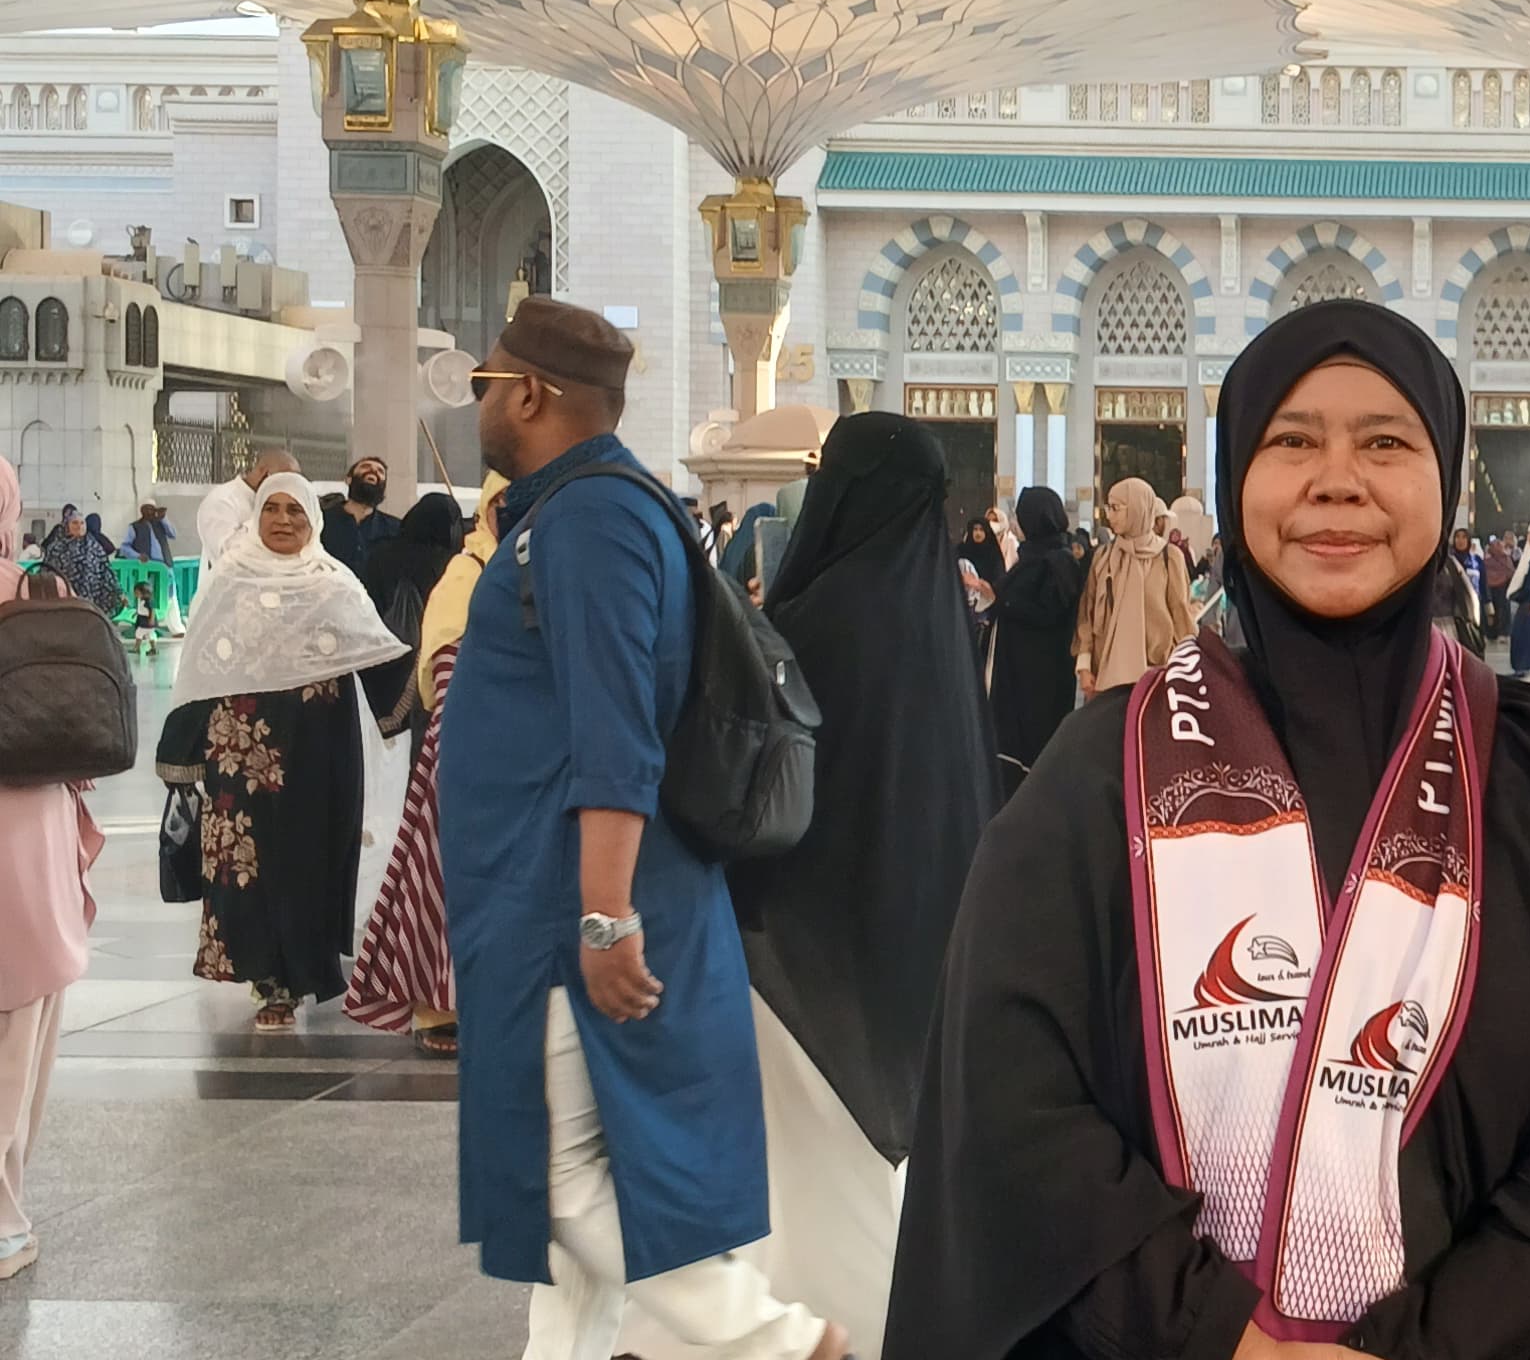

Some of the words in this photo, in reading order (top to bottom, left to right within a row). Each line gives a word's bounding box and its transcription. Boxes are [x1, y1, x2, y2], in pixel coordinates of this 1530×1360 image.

[1193, 1036, 1229, 1051] Umrah
[1233, 1035, 1241, 1045] &
[1246, 1033, 1267, 1045] Hajj
